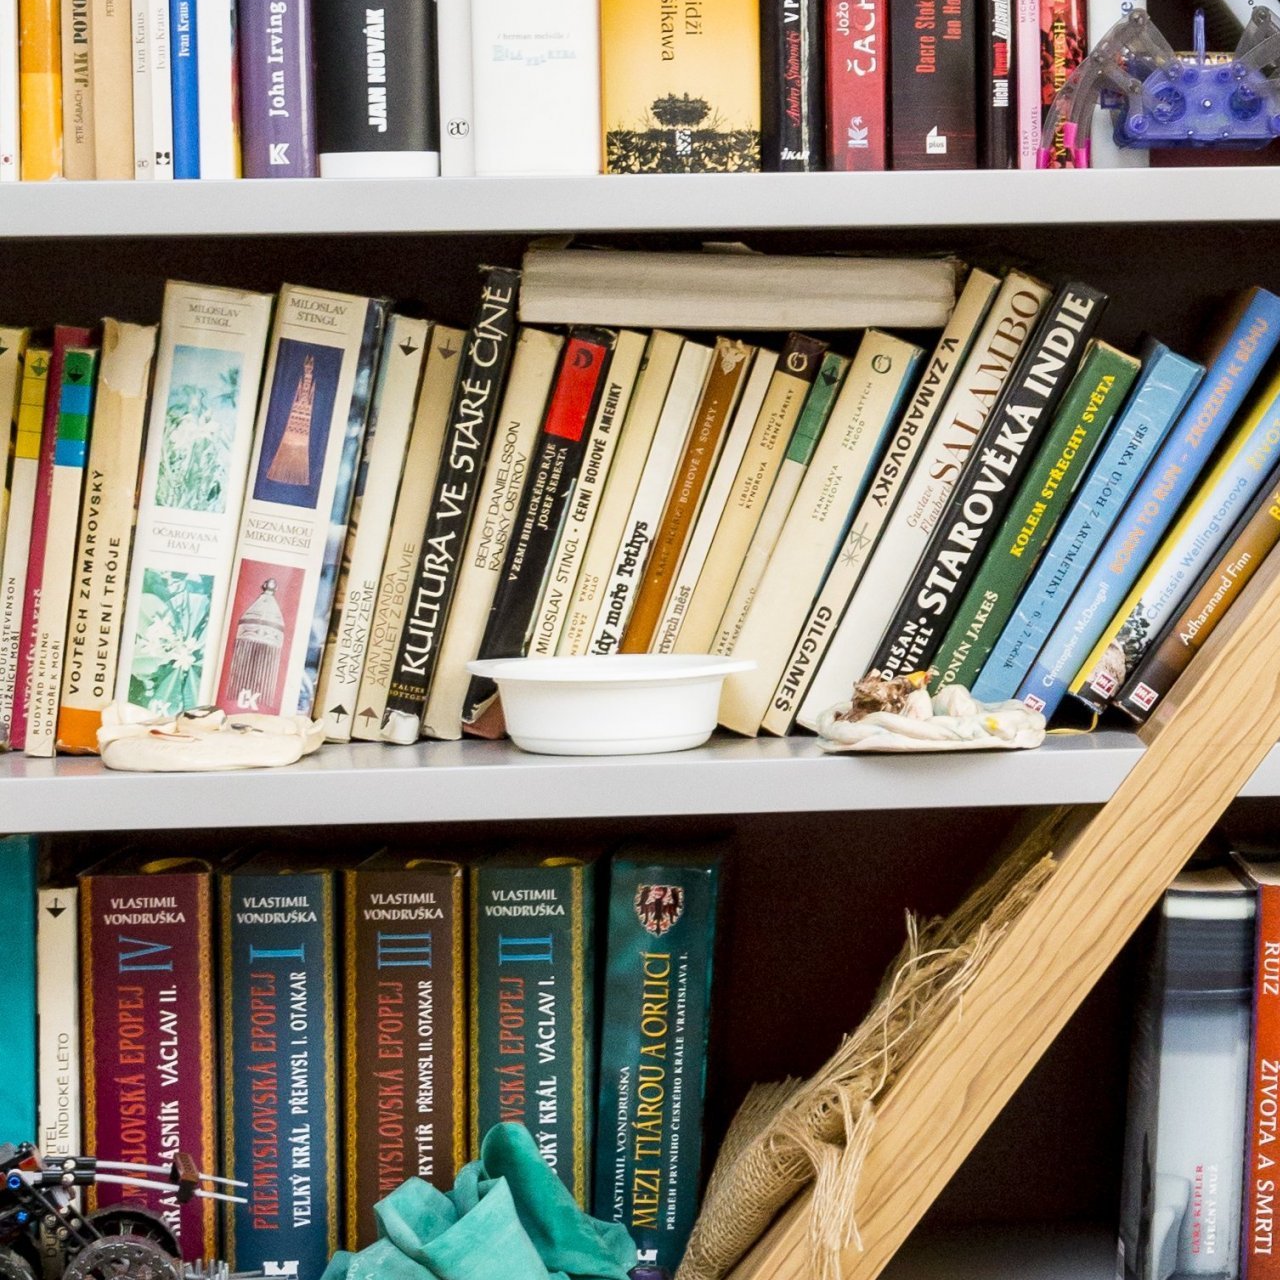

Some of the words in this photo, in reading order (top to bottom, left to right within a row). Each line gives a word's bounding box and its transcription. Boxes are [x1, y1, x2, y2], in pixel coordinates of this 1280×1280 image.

[268, 0, 287, 63] Irving
[364, 8, 385, 80] NOVÁK
[784, 12, 798, 23] V
[268, 70, 287, 117] John
[366, 84, 387, 133] JAN
[929, 290, 1041, 491] SALAMBO
[449, 378, 492, 474] STARÉ
[917, 399, 1041, 617] STAROVĚKÁ
[1022, 291, 1096, 406] INDIE
[1010, 499, 1047, 558] KOLEM
[1042, 424, 1085, 505] STŘECHY
[1083, 373, 1116, 424] SVĚTA
[437, 482, 468, 523] VE
[401, 526, 456, 676] KULTURA
[1178, 576, 1232, 648] Adharanand
[1227, 550, 1252, 579] Finn
[235, 909, 317, 925] VONDRUŠKA
[242, 896, 309, 909] VLASTIMIL
[640, 951, 671, 1038] ORLICÍ
[1263, 941, 1280, 996] RUIZ
[640, 1042, 667, 1062] A
[633, 1064, 665, 1162] TIÁROU
[1259, 1155, 1275, 1170] A
[631, 1165, 660, 1230] MEZI
[1255, 1179, 1275, 1256] SMRTI
